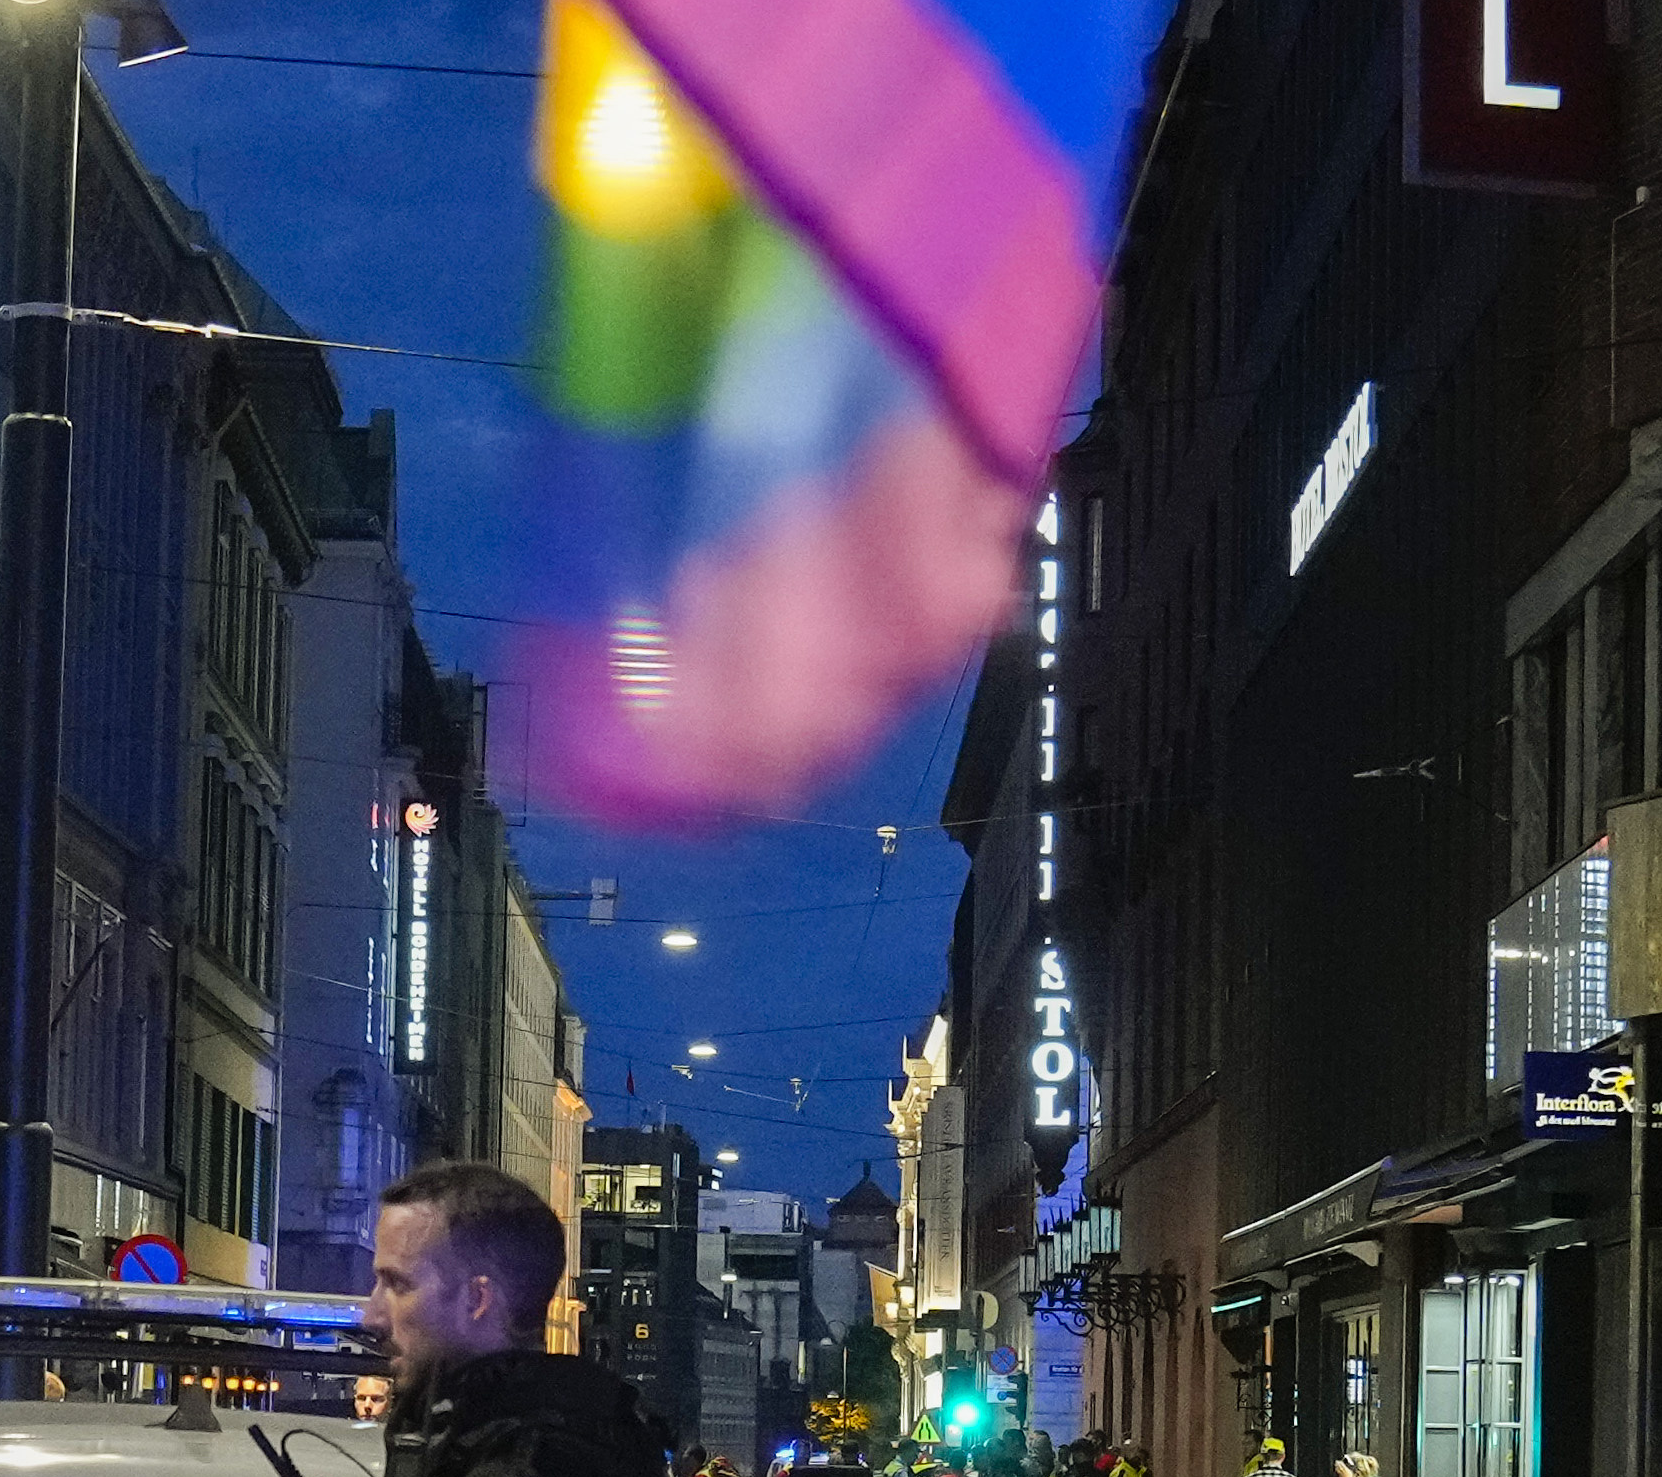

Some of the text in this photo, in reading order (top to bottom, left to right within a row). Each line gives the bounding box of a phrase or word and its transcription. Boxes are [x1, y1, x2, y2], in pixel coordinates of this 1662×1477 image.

[412, 838, 430, 917] HOTELL
[1535, 1092, 1617, 1113] Interflora
[634, 1323, 650, 1339] 6
